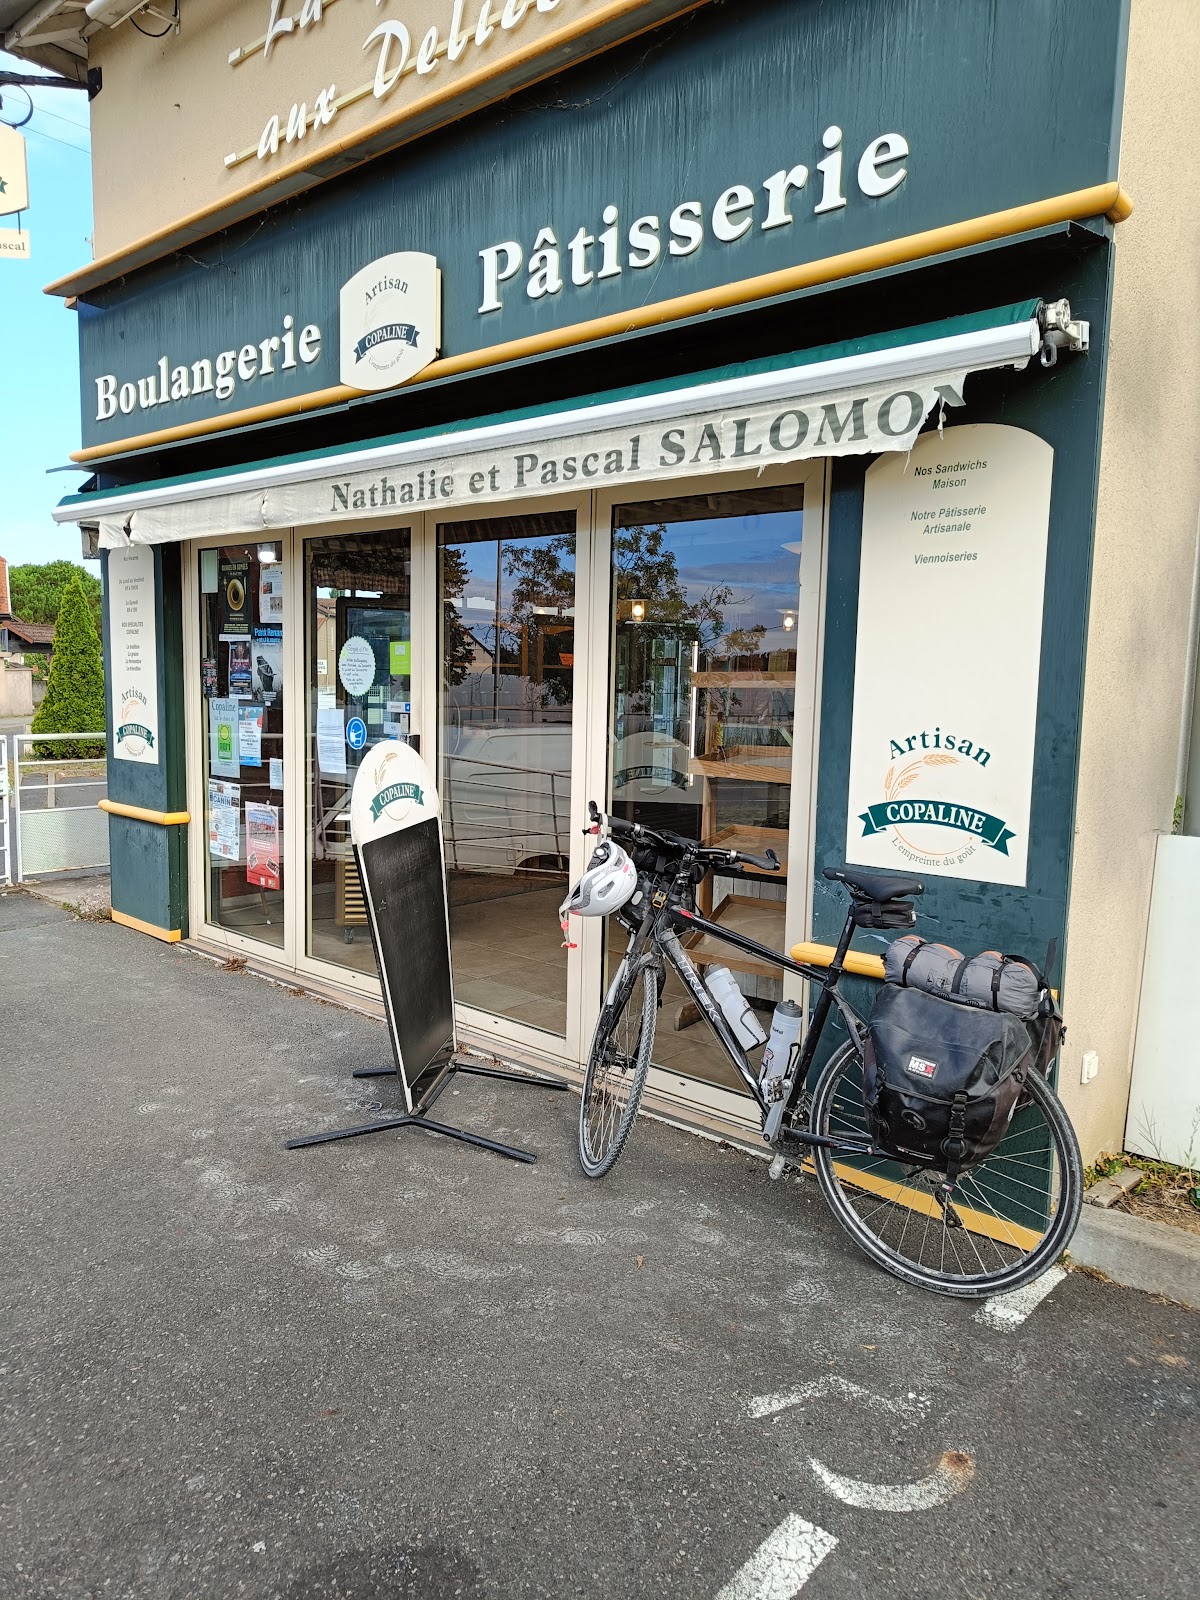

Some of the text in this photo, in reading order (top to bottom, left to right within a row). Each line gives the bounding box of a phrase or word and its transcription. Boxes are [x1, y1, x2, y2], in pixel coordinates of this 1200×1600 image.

[257, 0, 560, 159] aux Delic
[478, 125, 909, 314] Pâtisserie
[364, 275, 409, 306] Artisan
[365, 325, 408, 348] COPALINE
[95, 315, 321, 421] Boulangerie
[330, 469, 454, 512] Nathalie
[469, 464, 500, 494] et
[514, 434, 640, 489] Pascal
[914, 460, 988, 477] Nos Sandwichs
[932, 477, 966, 490] Maison
[910, 505, 987, 521] Notre Pâtisserie
[922, 521, 972, 535] Artisanale
[914, 551, 978, 565] Viennoiseries
[121, 686, 148, 706] Artisan
[212, 699, 236, 715] Copaline
[122, 724, 148, 739] COPALINE
[889, 727, 992, 768] Artisan
[379, 784, 415, 806] COPALINE
[886, 803, 987, 833] COPALINE
[892, 837, 977, 867] L'empreinte du goût
[677, 955, 721, 1022] TREK
[908, 1060, 934, 1075] MSX
